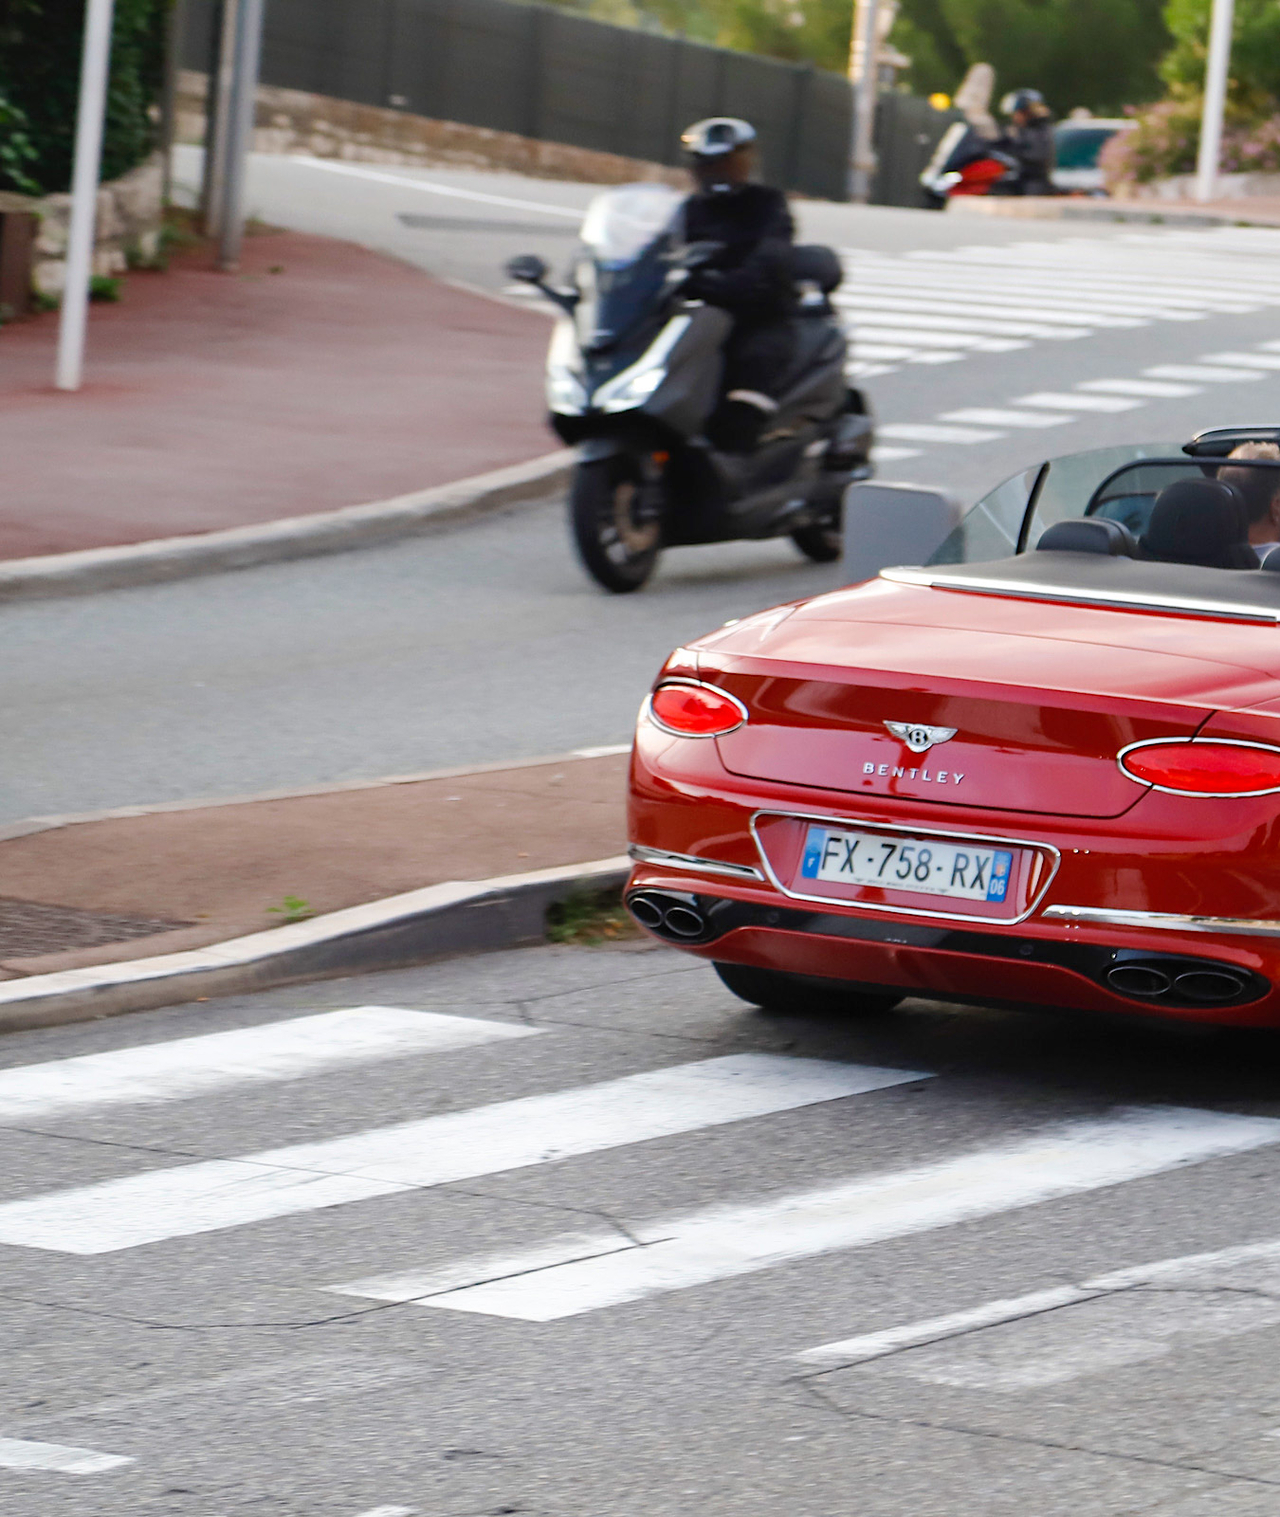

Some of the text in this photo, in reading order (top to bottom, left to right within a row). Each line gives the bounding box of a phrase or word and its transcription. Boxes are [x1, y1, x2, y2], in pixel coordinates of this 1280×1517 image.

[863, 762, 965, 785] BENTLEY
[821, 837, 991, 890] FX-758-RX
[989, 878, 1005, 896] 06
